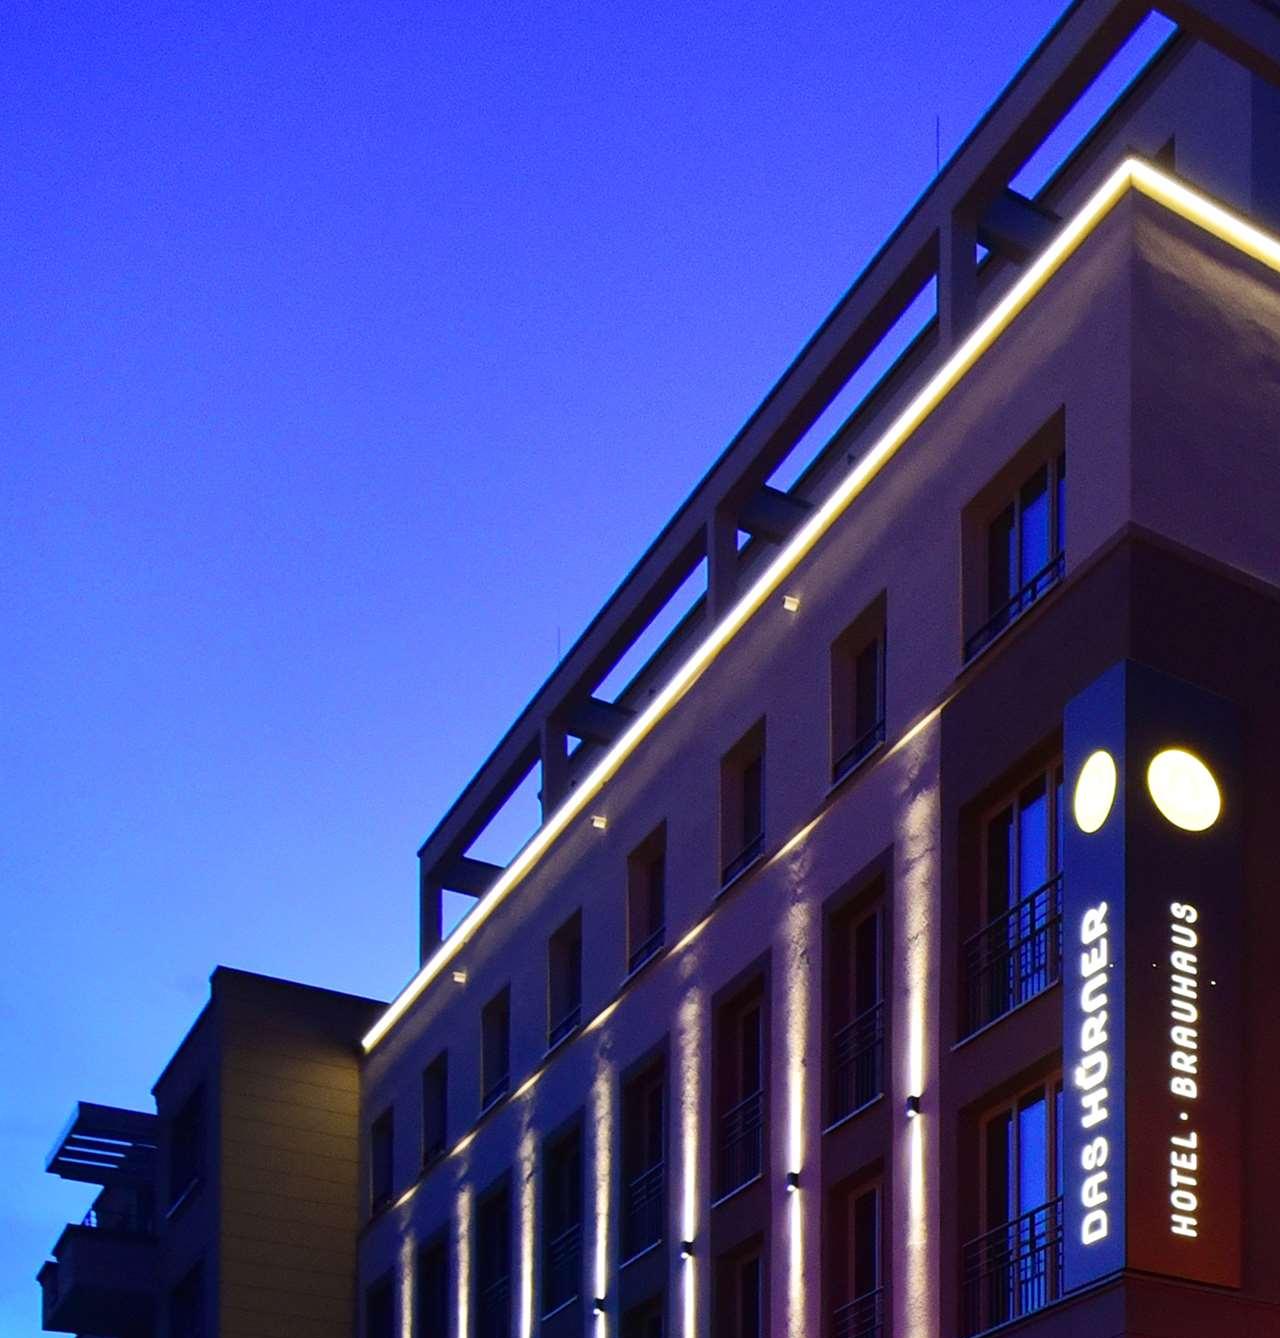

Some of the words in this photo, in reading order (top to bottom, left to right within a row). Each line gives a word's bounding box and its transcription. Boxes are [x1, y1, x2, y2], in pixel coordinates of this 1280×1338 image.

[1170, 902, 1198, 1099] BRAUHAUS
[1081, 1136, 1109, 1245] DAS
[1170, 1131, 1198, 1237] HOTEL
